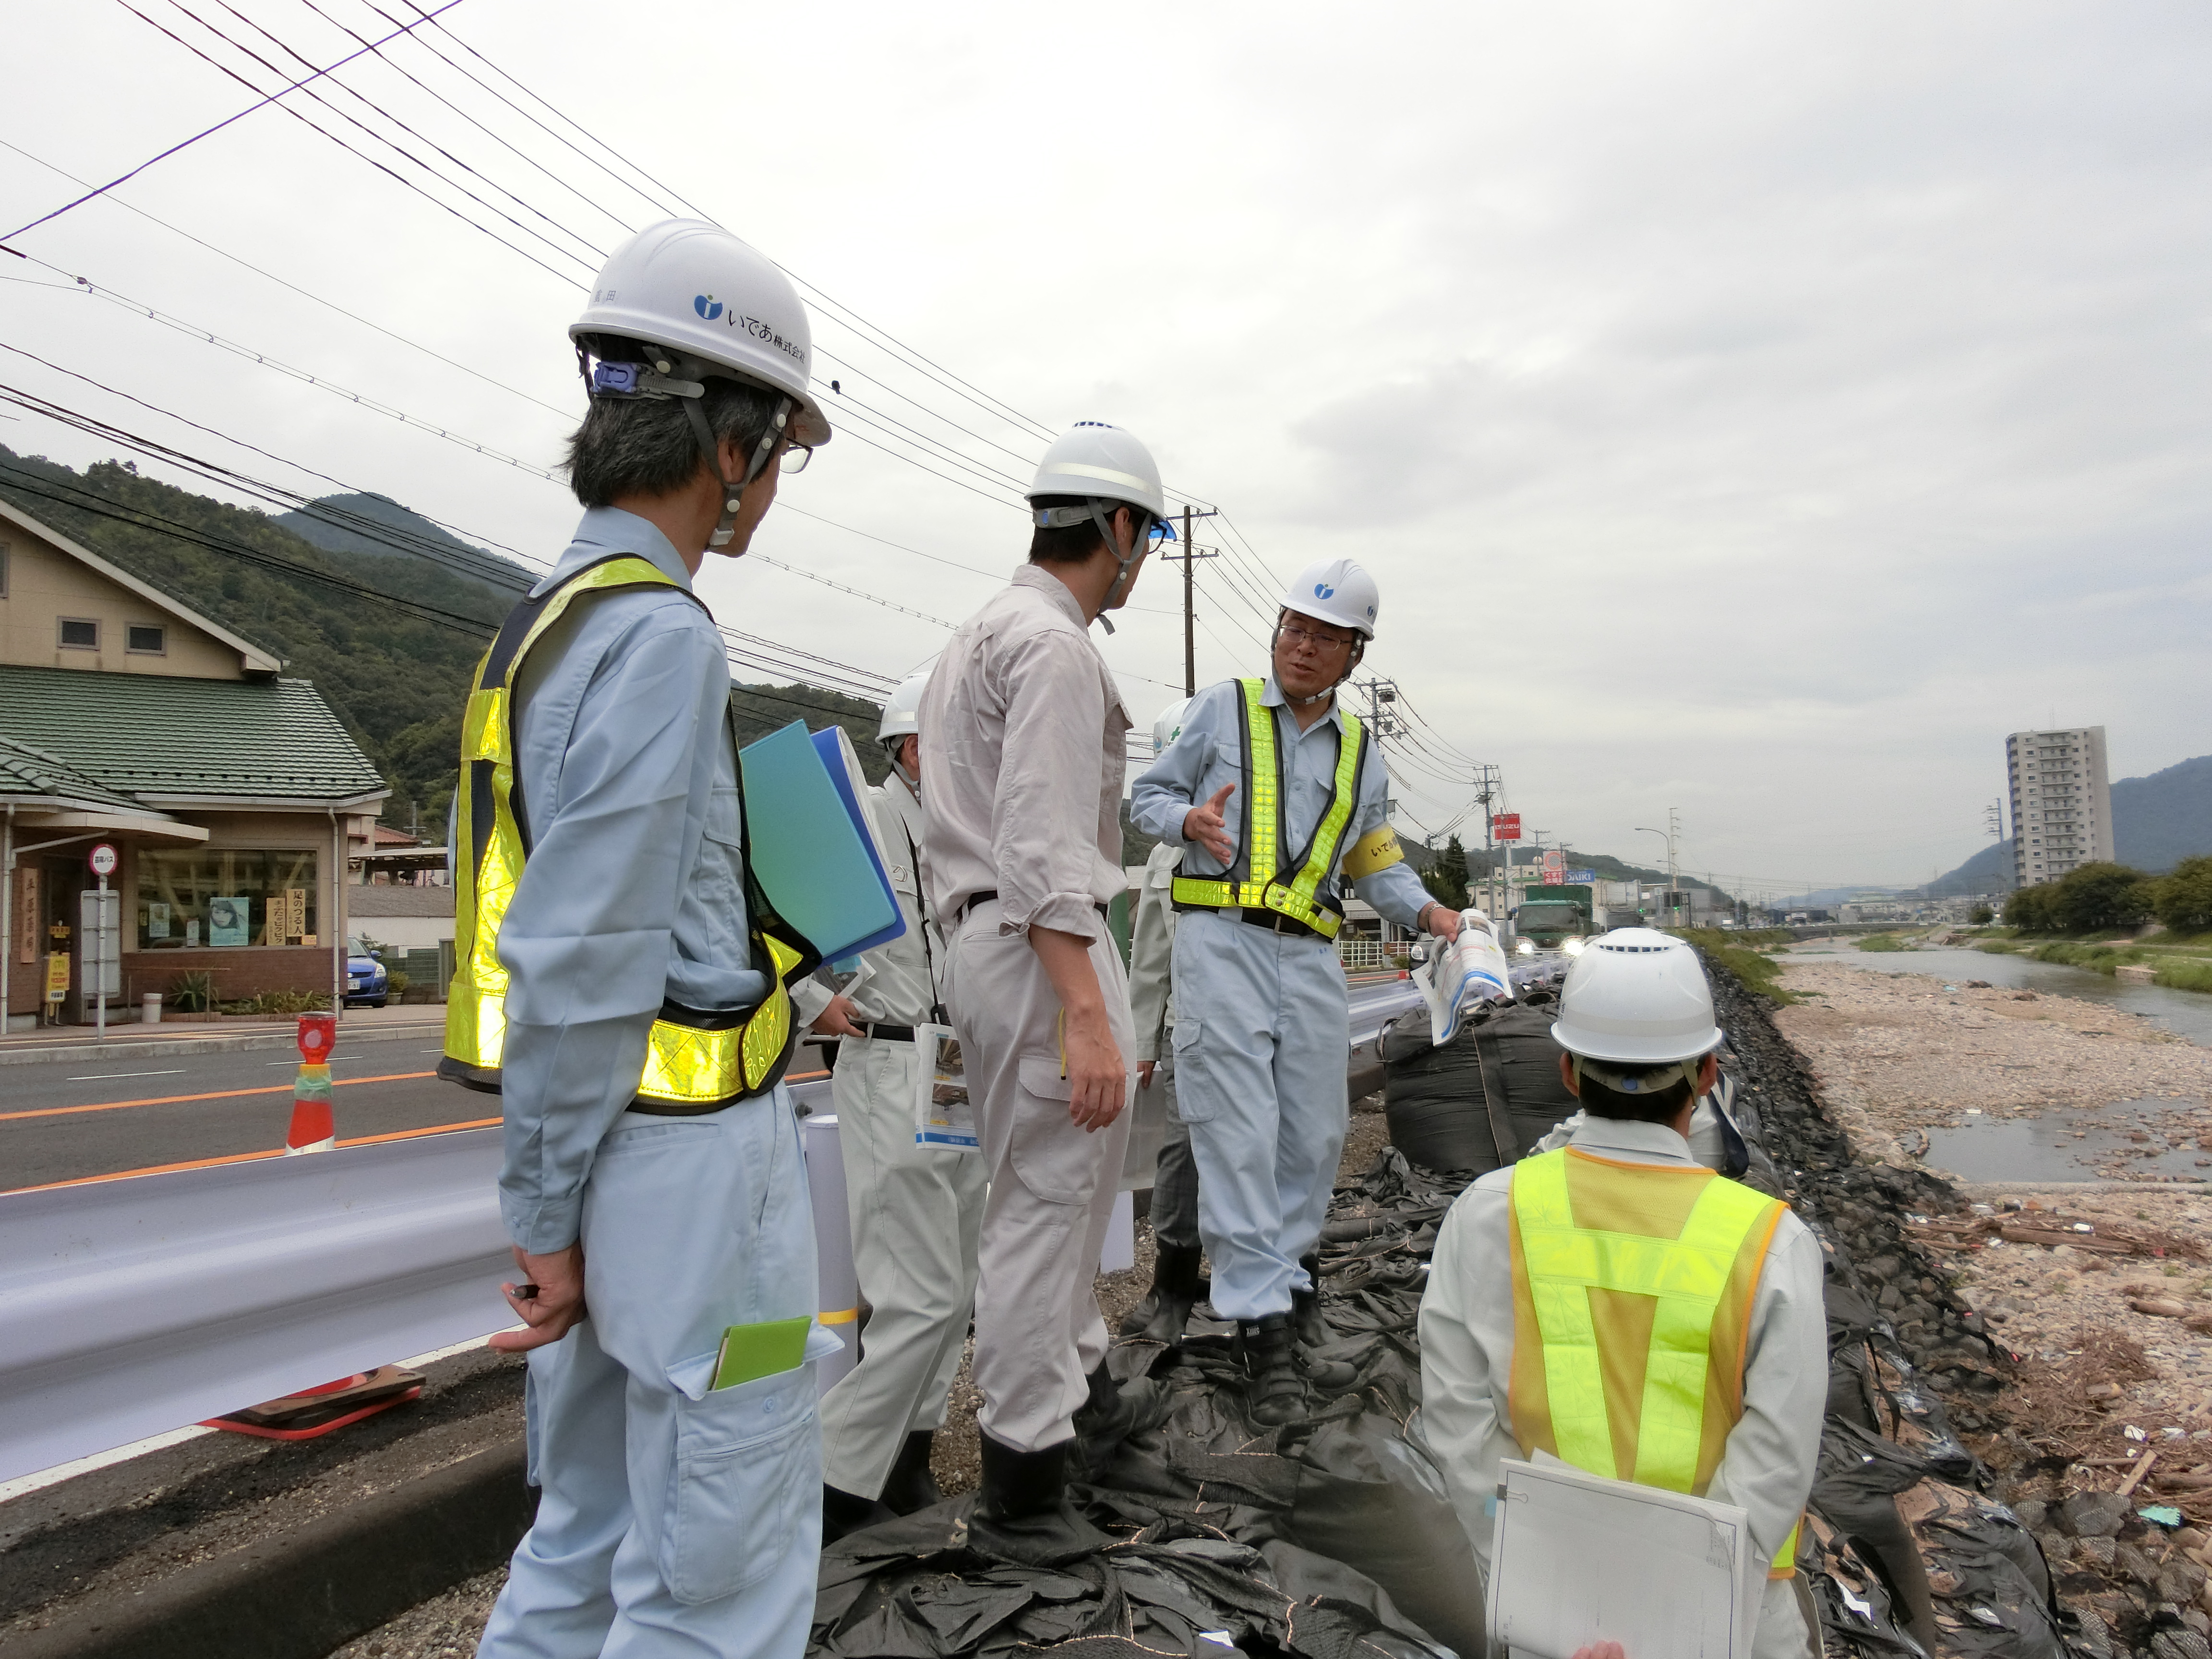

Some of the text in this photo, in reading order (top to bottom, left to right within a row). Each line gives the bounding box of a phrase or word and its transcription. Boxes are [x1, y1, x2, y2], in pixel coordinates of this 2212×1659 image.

[728, 309, 806, 364] いであ株式会社
[293, 890, 303, 934] 足のつる人
